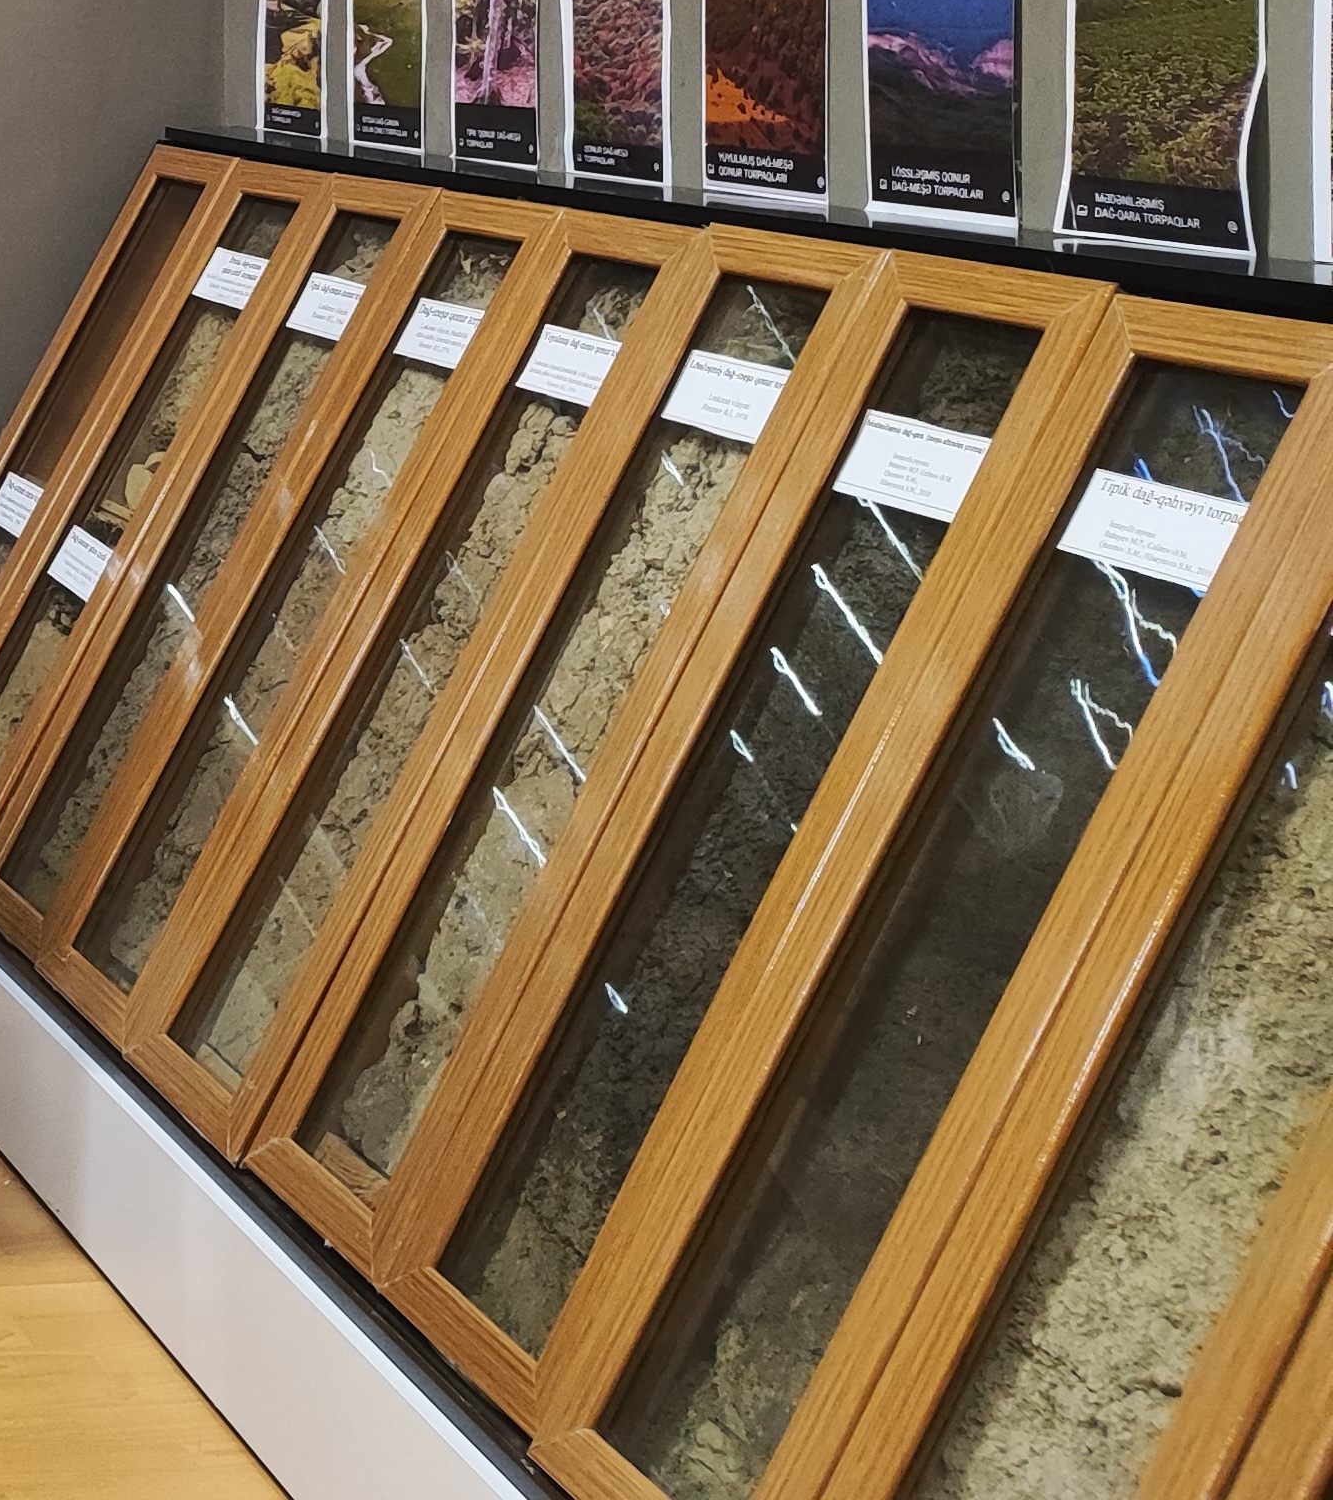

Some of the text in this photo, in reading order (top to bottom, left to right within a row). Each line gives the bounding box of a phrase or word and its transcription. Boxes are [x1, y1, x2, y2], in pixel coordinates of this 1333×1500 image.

[718, 165, 743, 178] QONUR
[941, 171, 971, 184] QONUR
[934, 184, 984, 200] TORPAQLARI
[1094, 207, 1201, 229] DAĞ-QARA TORPAQLAR
[1099, 477, 1131, 497] Tipik
[1132, 486, 1205, 518] dağ-qəhvəyi
